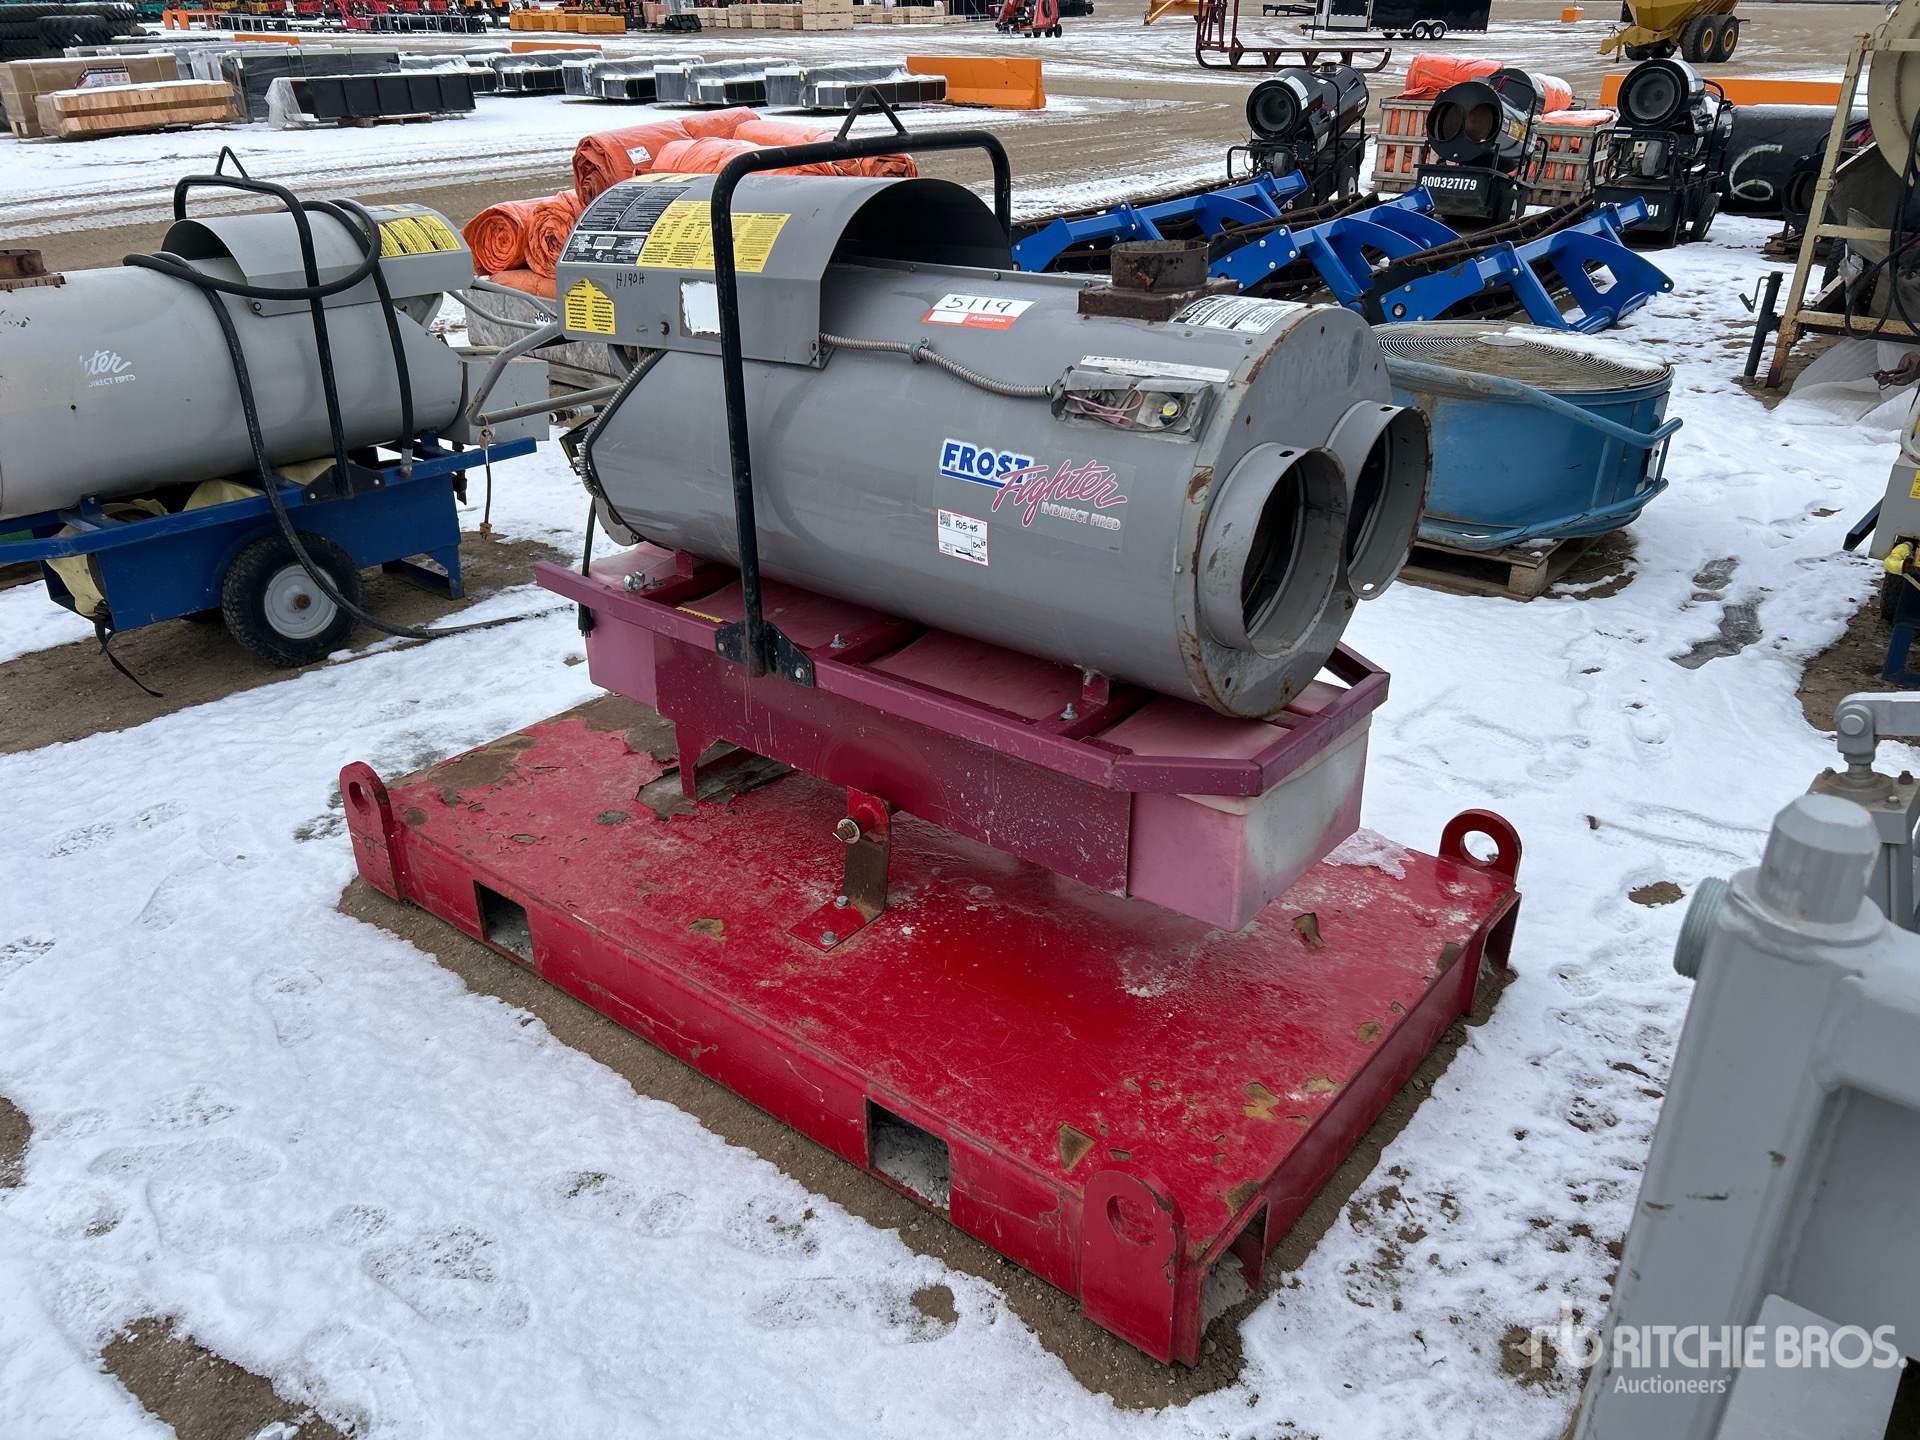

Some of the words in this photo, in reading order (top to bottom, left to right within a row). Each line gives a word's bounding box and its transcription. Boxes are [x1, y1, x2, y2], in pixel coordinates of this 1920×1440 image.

[1421, 176, 1478, 191] 800327179
[1729, 144, 1783, 201] 6
[945, 297, 1013, 314] 5119
[941, 441, 1032, 486] FROST
[991, 459, 1128, 527] Fighter
[1041, 501, 1089, 524] INDIRECT
[1090, 512, 1122, 531] FIRED
